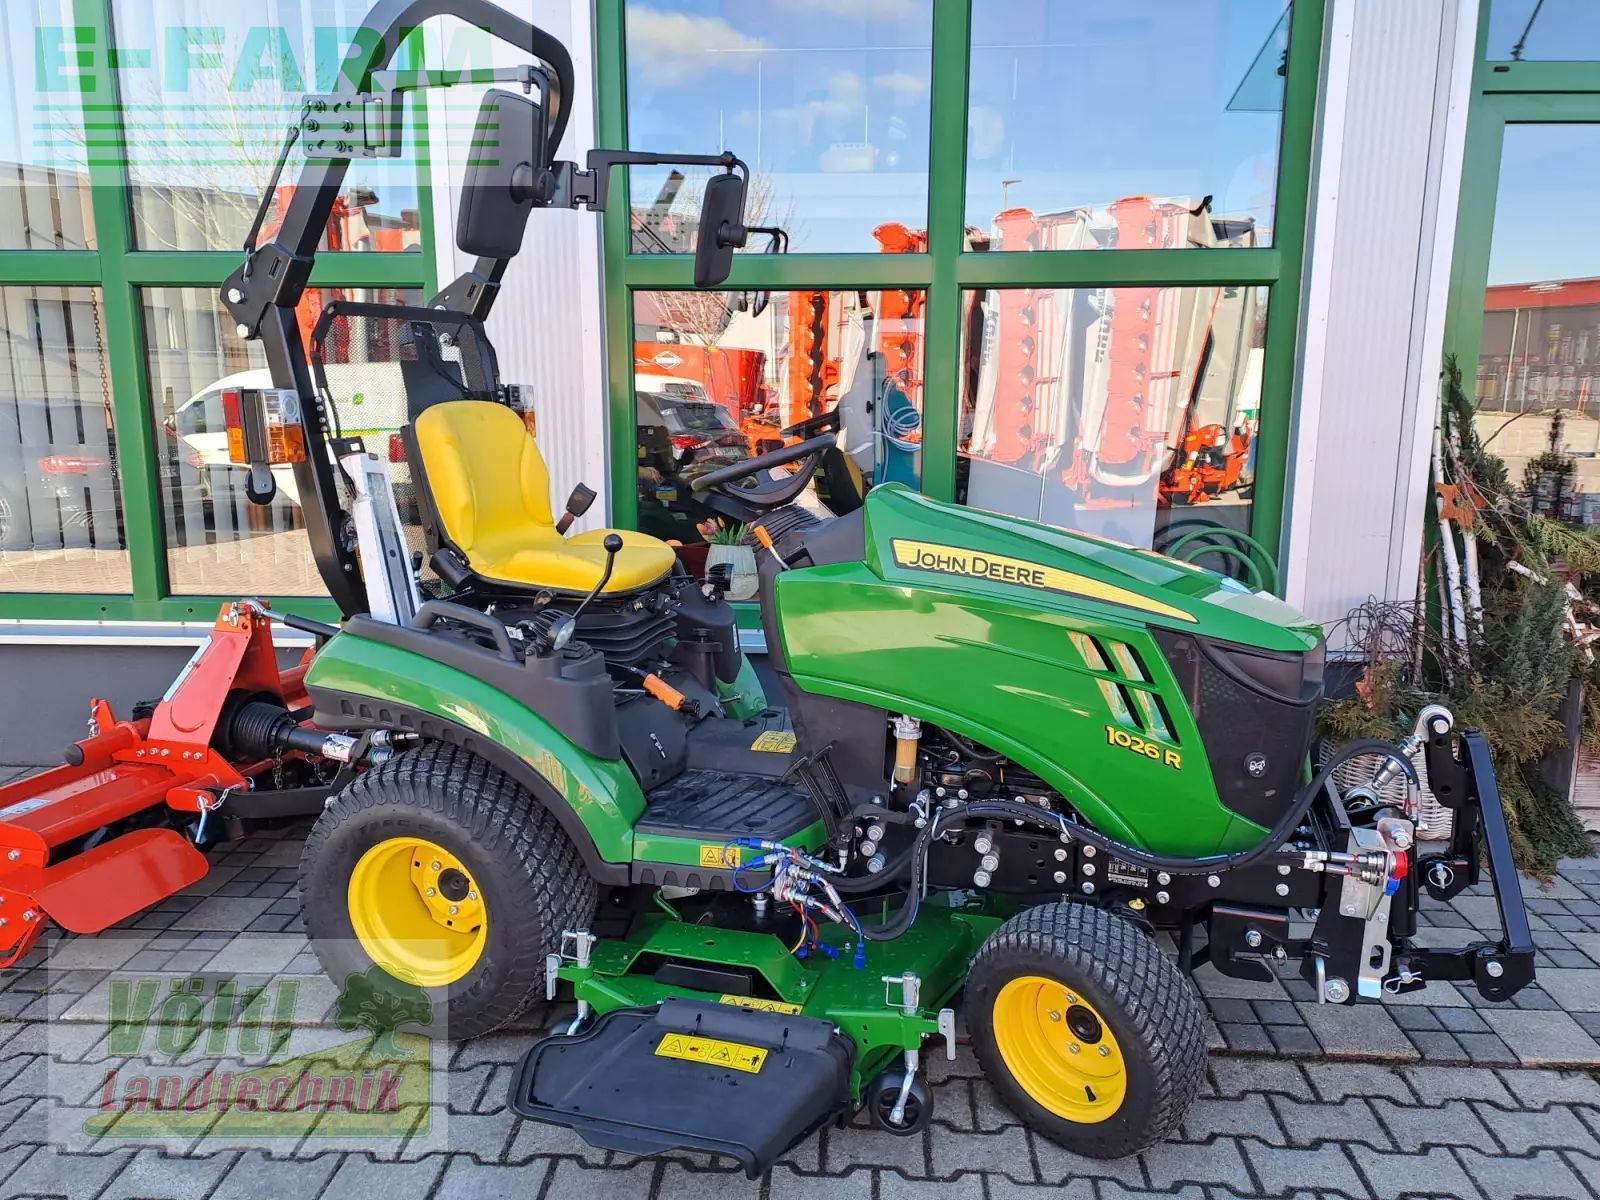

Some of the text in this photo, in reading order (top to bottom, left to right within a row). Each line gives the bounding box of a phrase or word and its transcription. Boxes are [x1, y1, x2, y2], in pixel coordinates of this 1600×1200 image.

[909, 549, 1045, 586] JOHN DEERE
[1105, 725, 1182, 770] 1026 R
